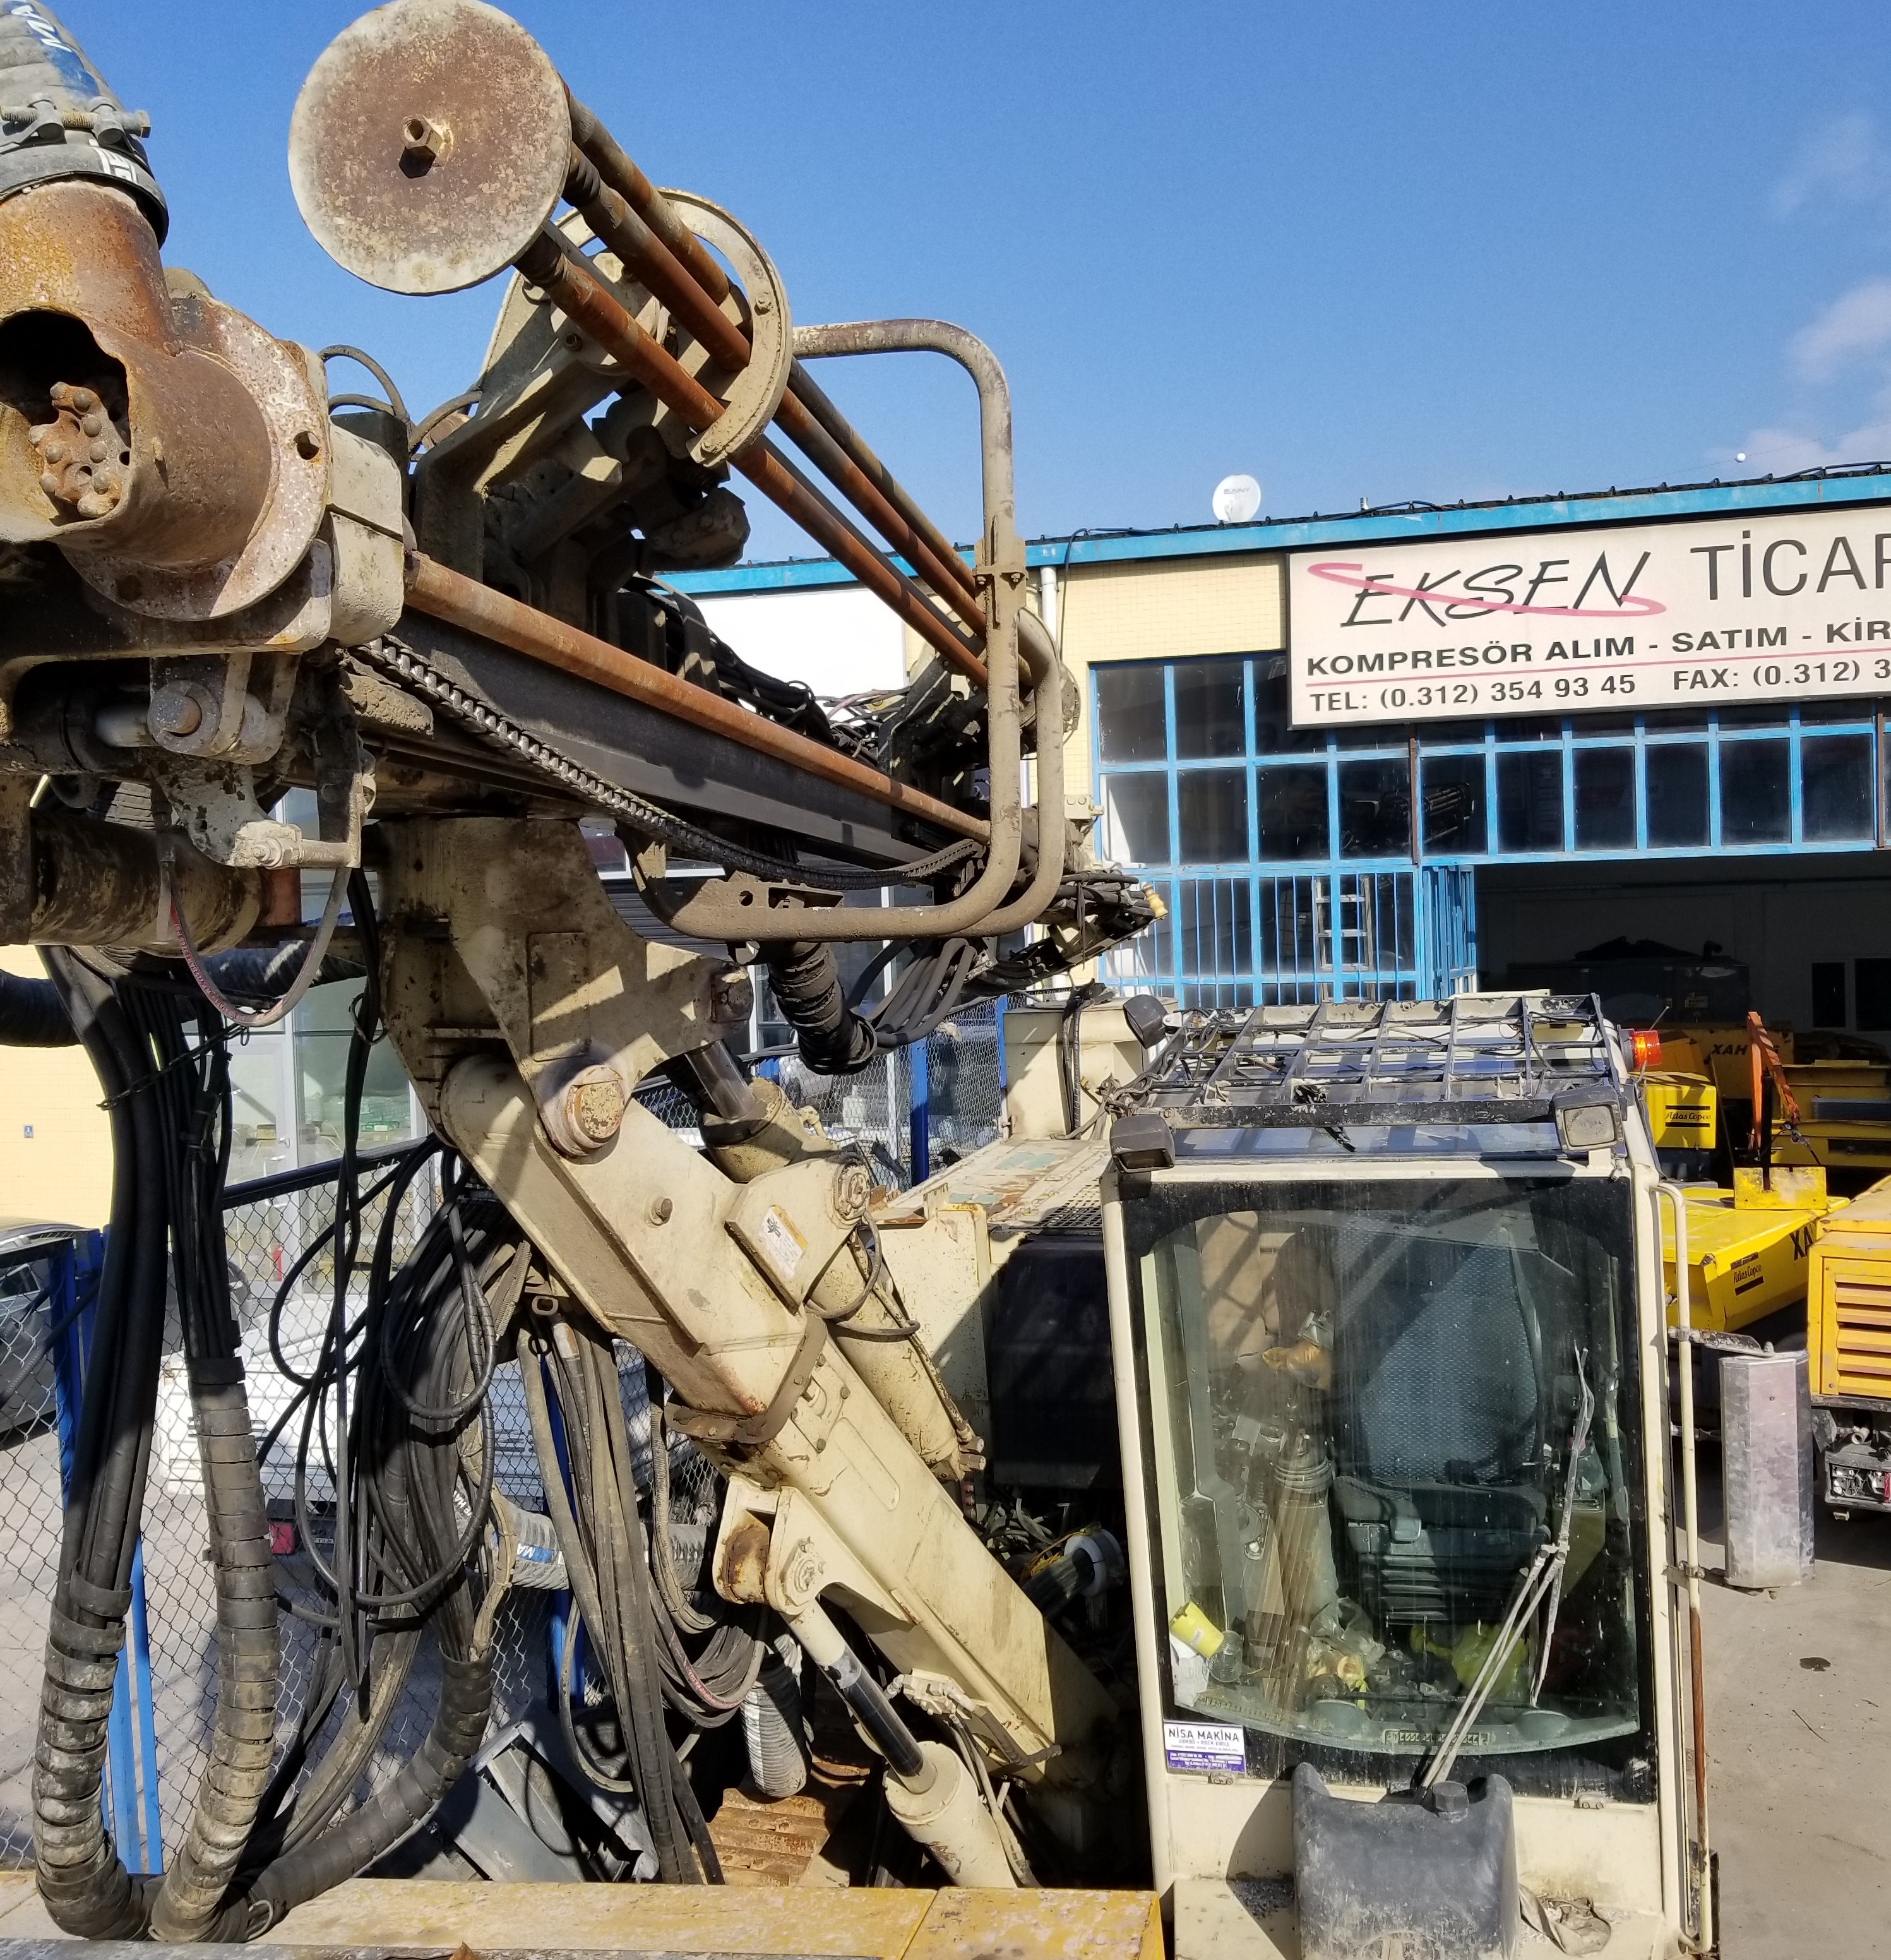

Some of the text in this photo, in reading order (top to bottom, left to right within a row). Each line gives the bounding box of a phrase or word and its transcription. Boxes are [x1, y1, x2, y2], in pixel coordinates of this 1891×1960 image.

[1339, 550, 1652, 628] EKSEN
[1307, 640, 1533, 676] KOMPRESÖR
[1544, 636, 1634, 660] ALIM
[1671, 626, 1787, 652] SATIM
[1309, 691, 1368, 712] TEL:
[1380, 683, 1479, 709] (0.312)
[1490, 679, 1543, 702] 354
[1554, 676, 1589, 698] 93
[1600, 674, 1636, 695] 45
[1673, 667, 1739, 690] FAX:
[1753, 659, 1861, 687] (0.312)
[1665, 1112, 1711, 1121] Atlas Copco
[1733, 1264, 1761, 1284] Atlas Copco
